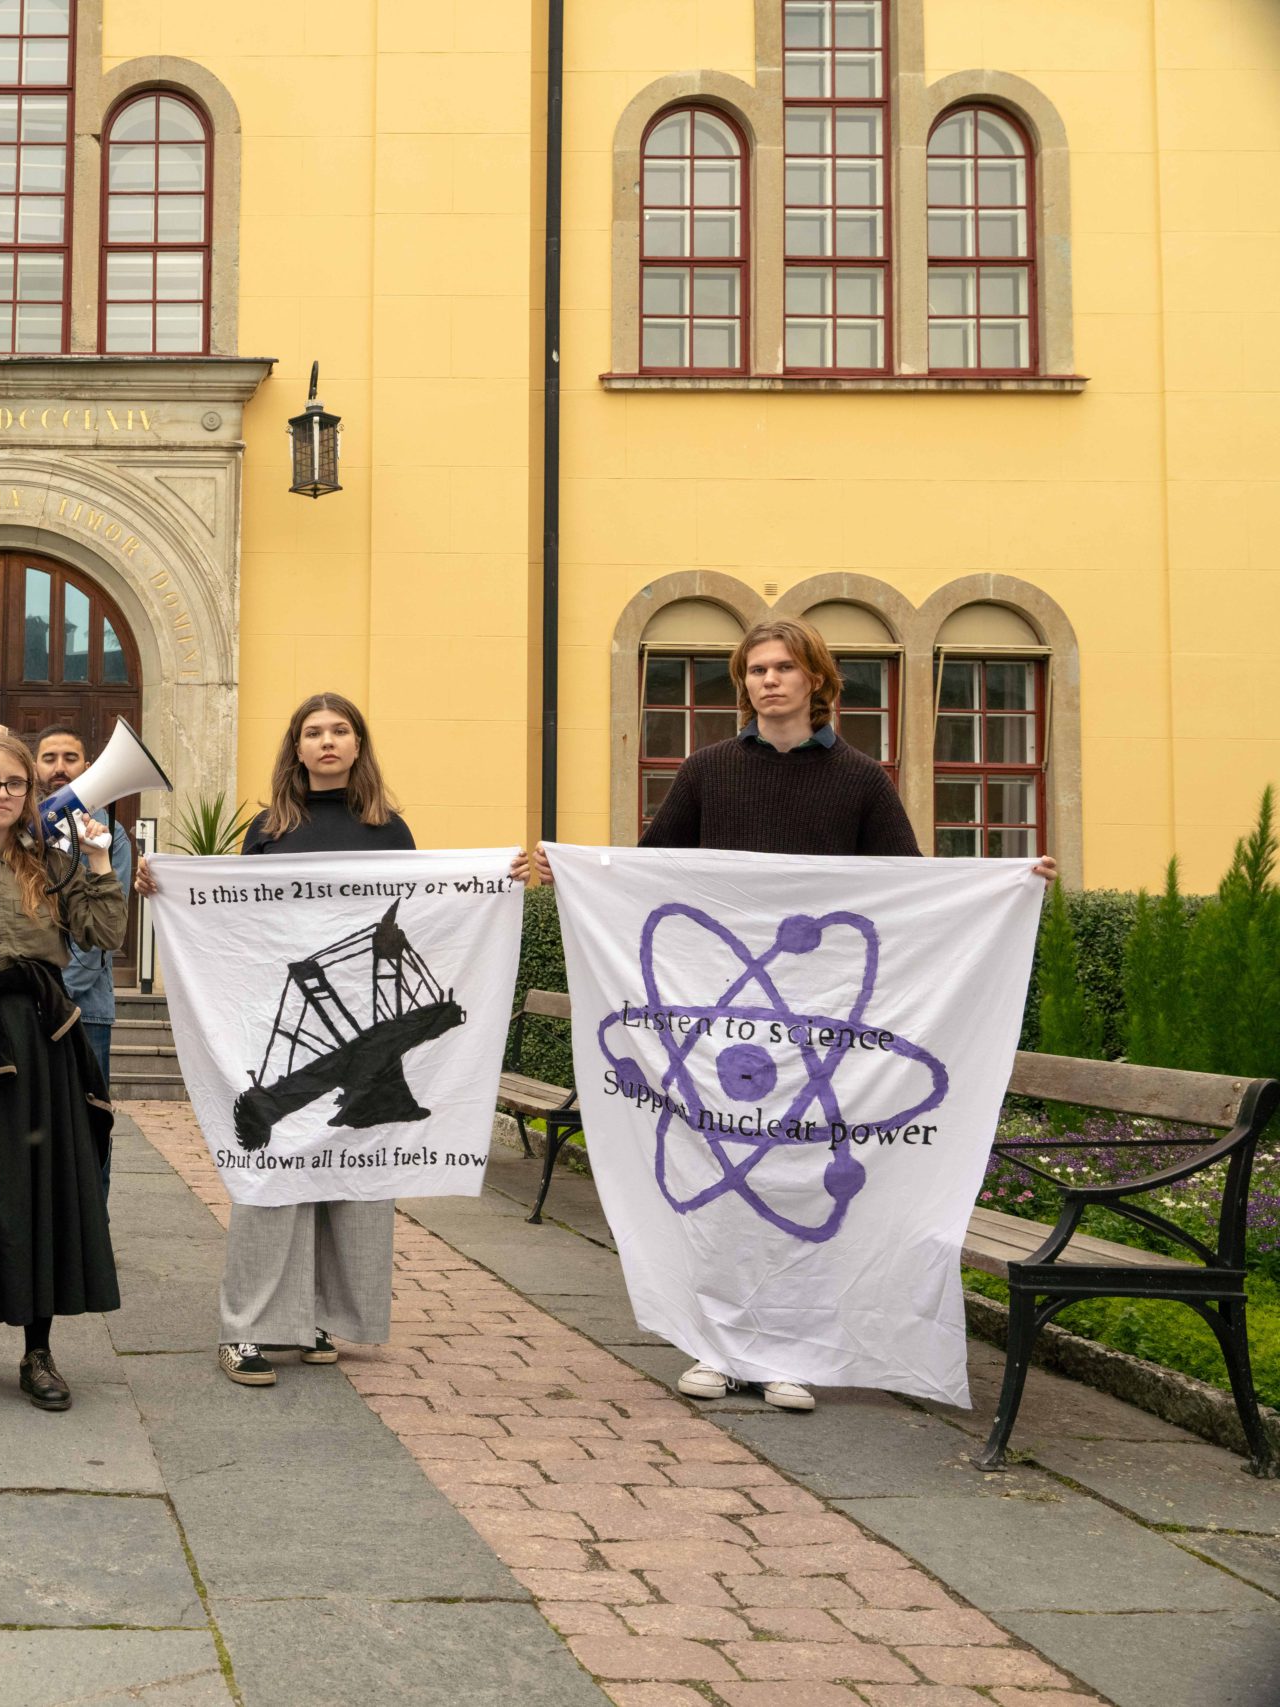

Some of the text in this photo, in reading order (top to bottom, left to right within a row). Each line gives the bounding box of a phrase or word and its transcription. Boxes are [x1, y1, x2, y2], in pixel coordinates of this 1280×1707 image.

[57, 497, 140, 557] TIMOR
[149, 570, 200, 676] DOMINI
[190, 875, 513, 905] Is this the 21st century or what?
[622, 1000, 895, 1051] Listen to science
[604, 1070, 937, 1149] Suppot nuclear power
[216, 1146, 488, 1170] Shut down all fossil fuels now
